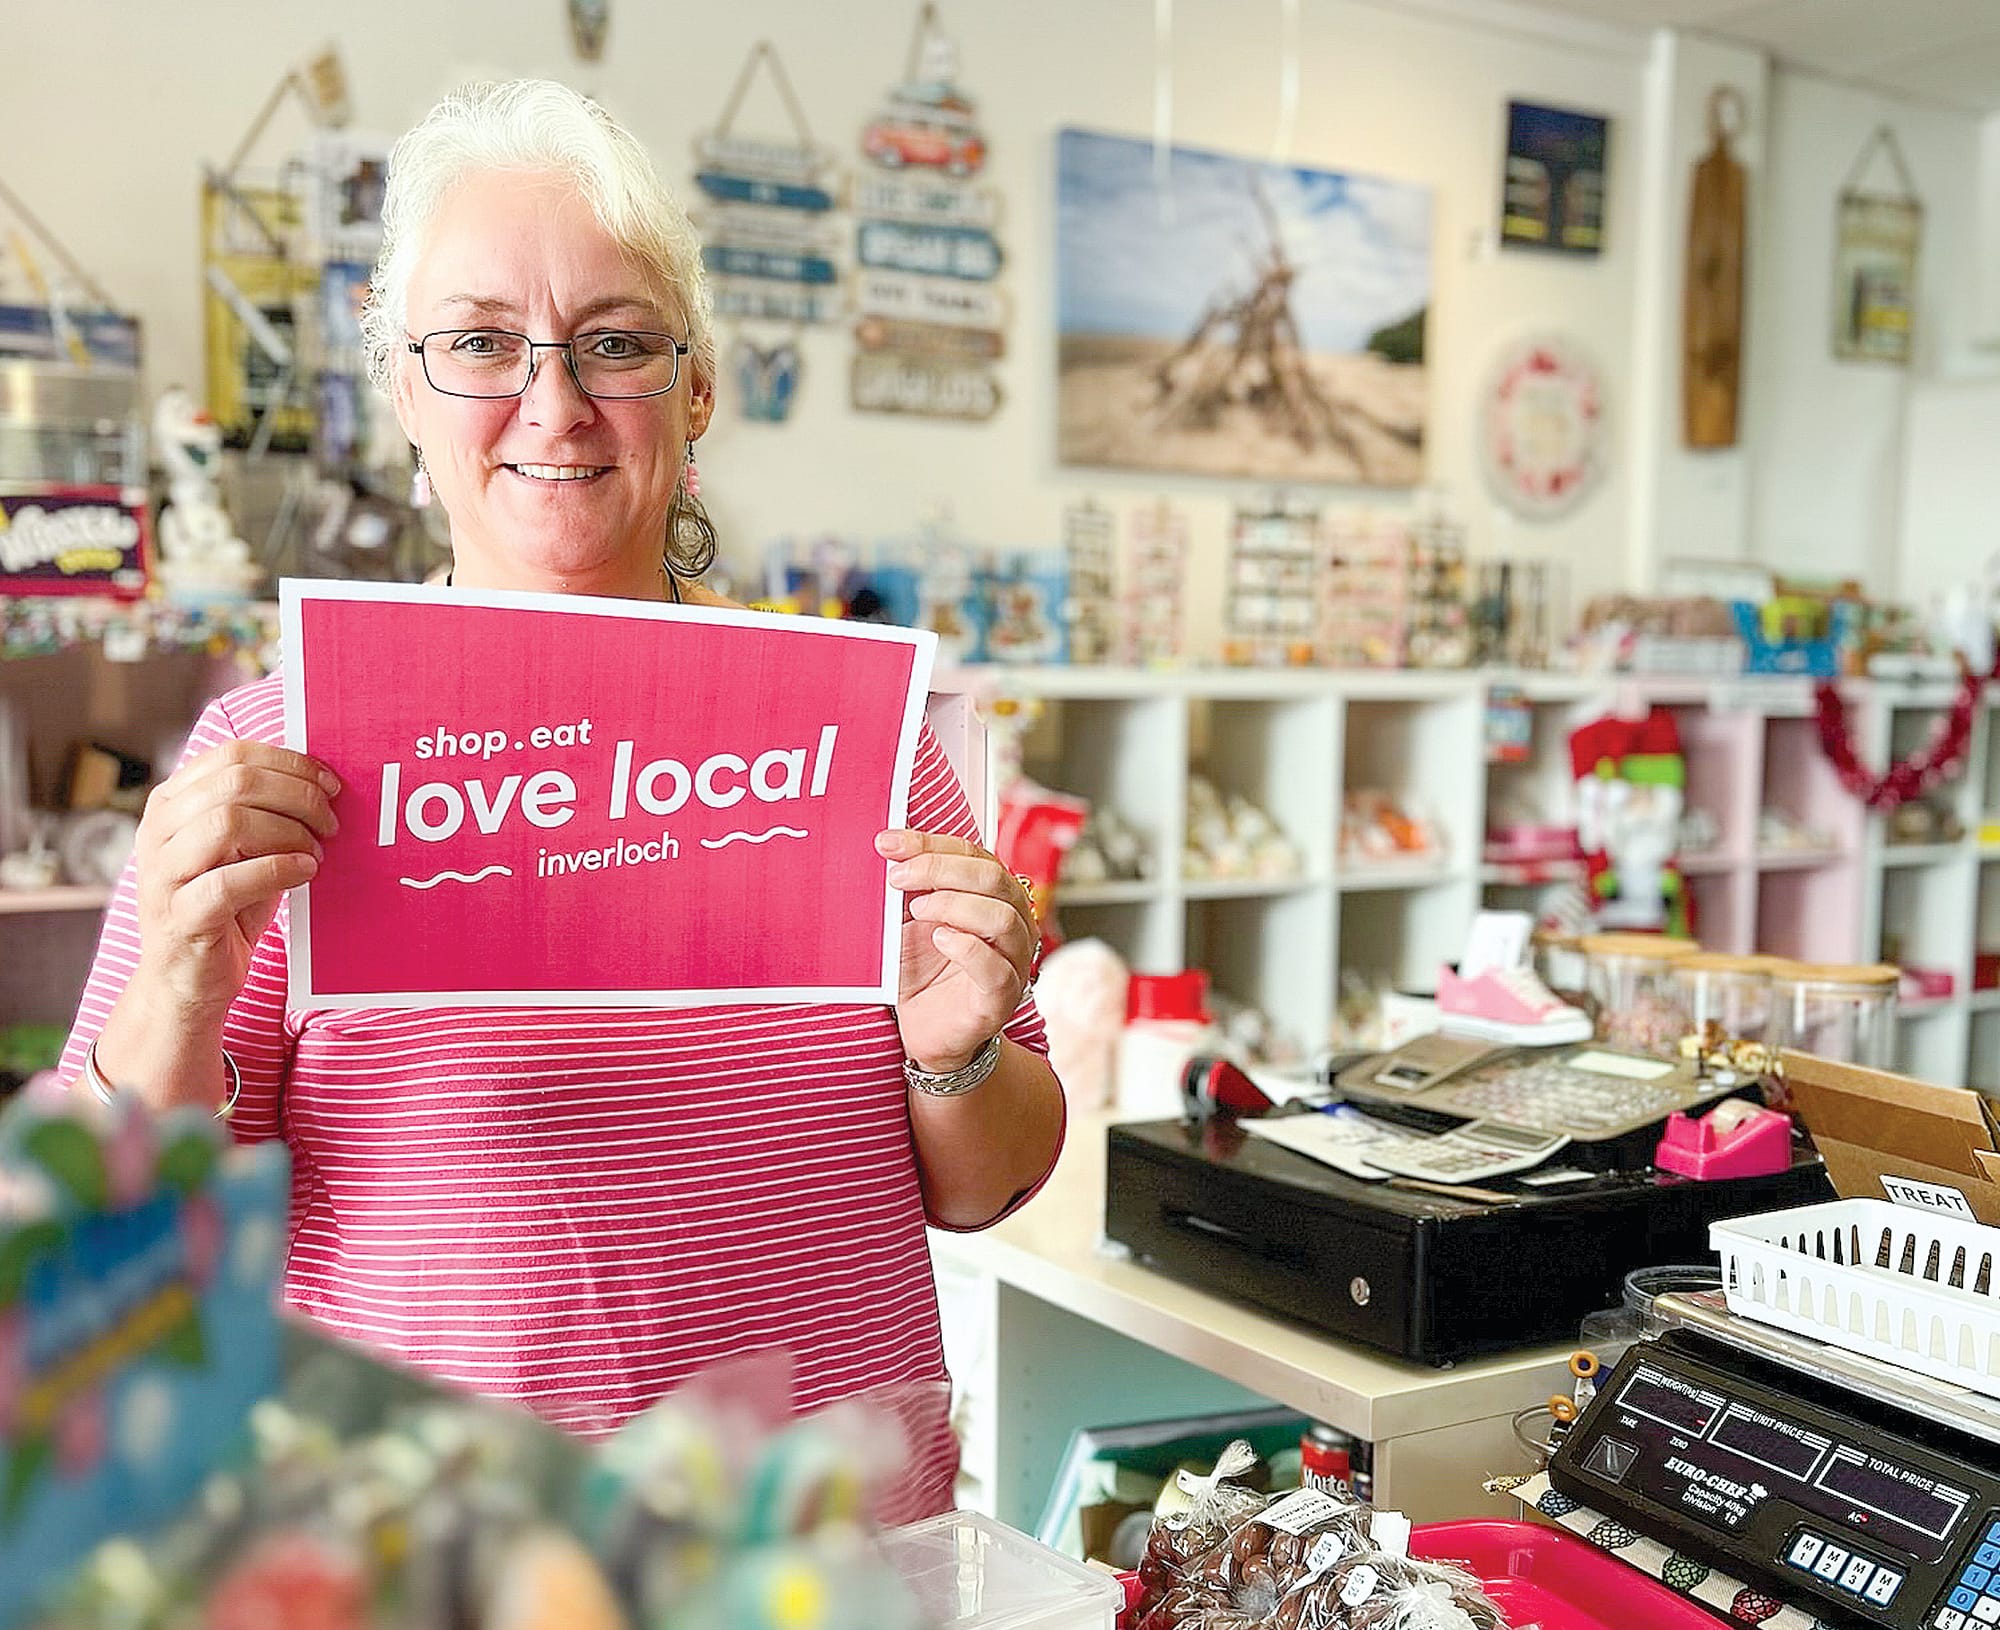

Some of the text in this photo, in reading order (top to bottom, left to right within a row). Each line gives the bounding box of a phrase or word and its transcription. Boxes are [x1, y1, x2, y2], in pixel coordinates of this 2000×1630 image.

[377, 724, 839, 847] love local
[537, 831, 680, 878] inverloch
[1885, 1183, 1963, 1211] TREAT
[1752, 1413, 1803, 1440] UNIT PRICE
[1669, 1436, 1689, 1450] ZERO
[1868, 1457, 1935, 1492] TOTAL PRICE
[1687, 1483, 1747, 1517] Capacity 40kg
[1681, 1493, 1738, 1525] Division 1g
[1803, 1540, 1815, 1551] M
[1799, 1552, 1806, 1560] 1
[1827, 1551, 1840, 1562] M
[1983, 1551, 1994, 1561] 4
[1822, 1563, 1832, 1573] 2
[1853, 1563, 1866, 1574] M
[1848, 1575, 1857, 1585] 3
[1879, 1574, 1893, 1586] M
[1971, 1571, 1980, 1583] 1
[1875, 1587, 1883, 1596] 4
[1946, 1611, 1958, 1621] M
